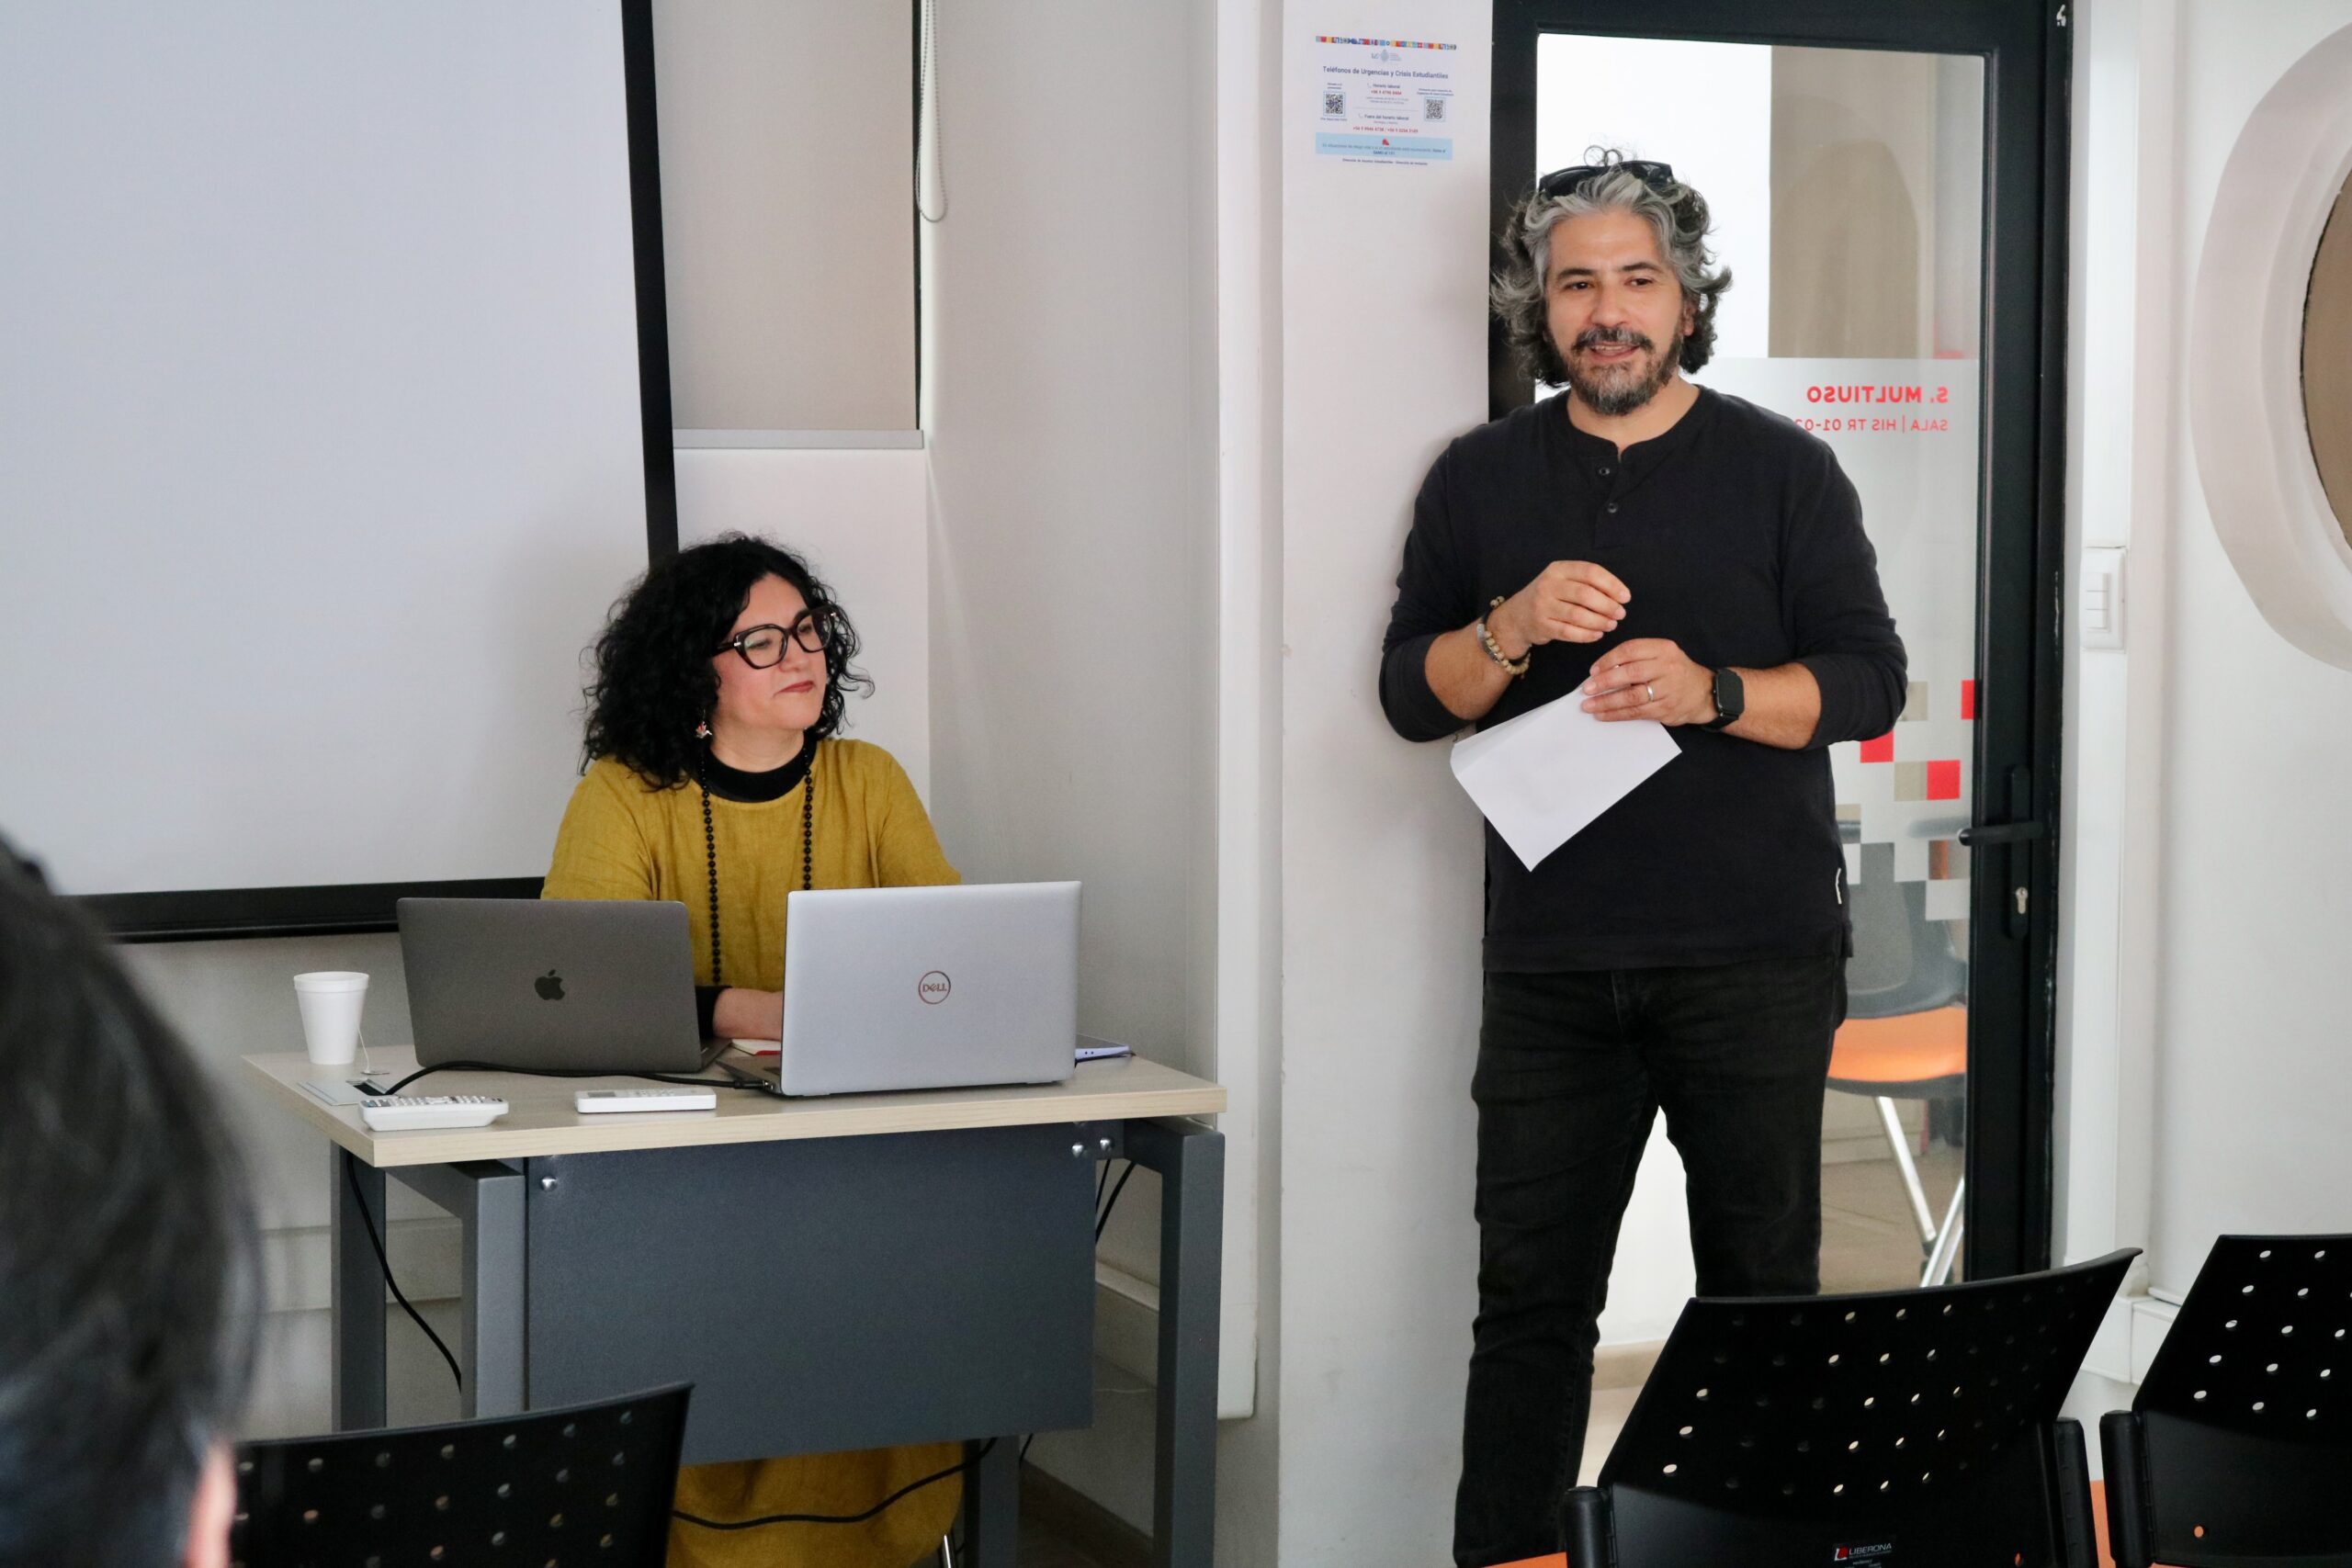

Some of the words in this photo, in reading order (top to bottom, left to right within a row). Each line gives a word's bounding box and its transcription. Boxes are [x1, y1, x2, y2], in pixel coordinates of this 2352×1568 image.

[1323, 66, 1351, 74] Teléfonos
[1361, 68, 1389, 76] Urgencias
[922, 983, 947, 993] DELL
[1849, 1542, 1893, 1555] LIBERONA
